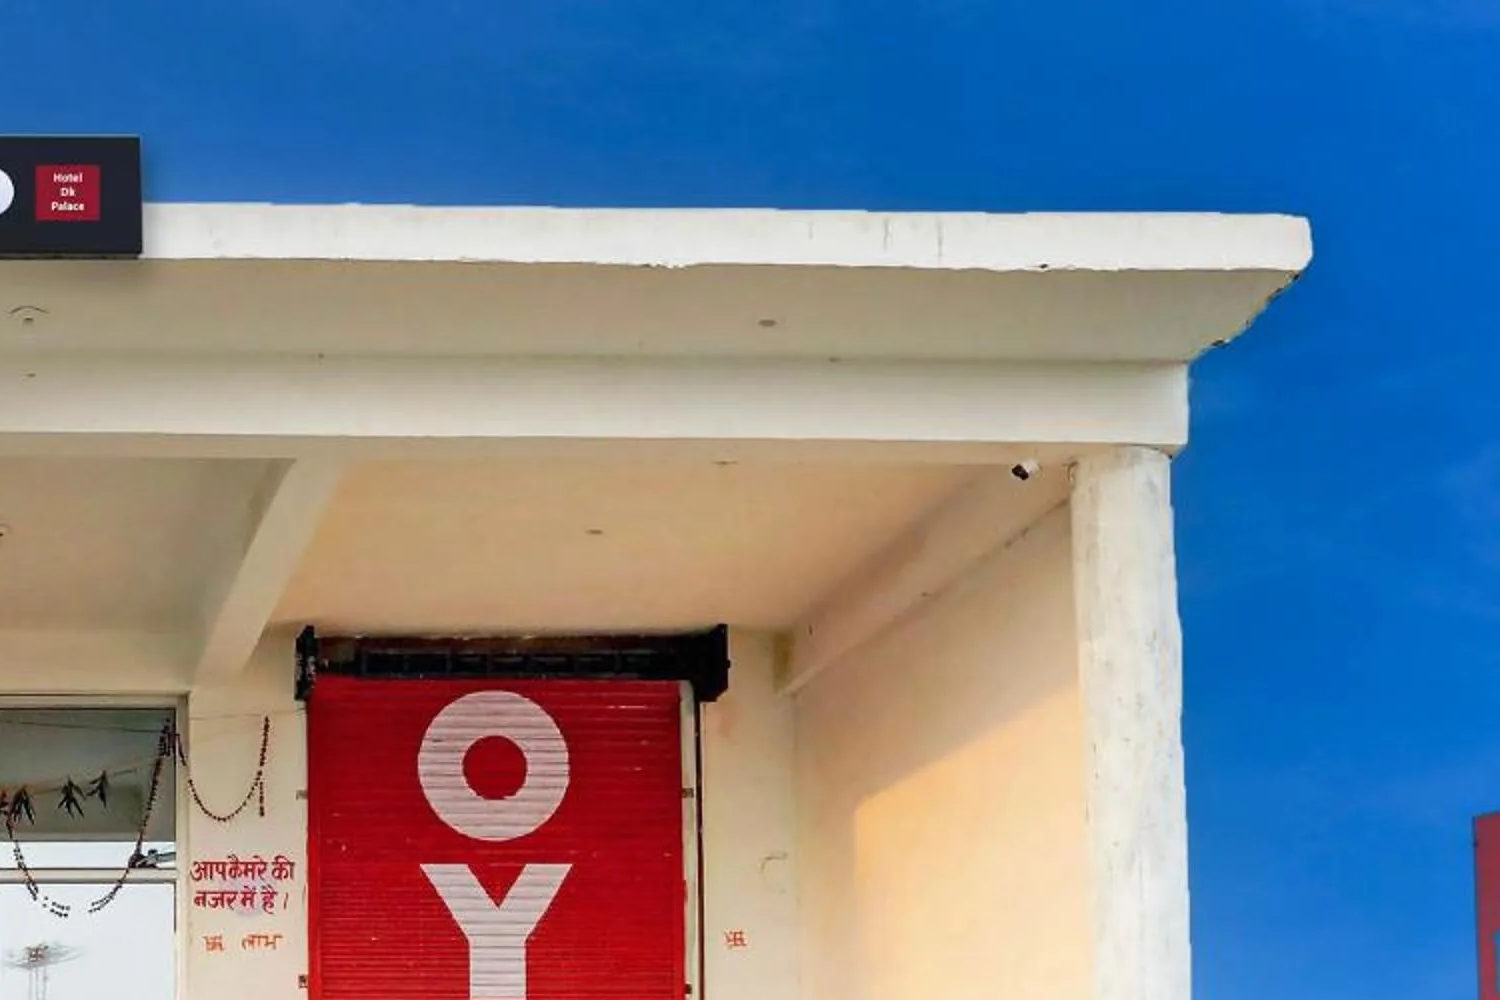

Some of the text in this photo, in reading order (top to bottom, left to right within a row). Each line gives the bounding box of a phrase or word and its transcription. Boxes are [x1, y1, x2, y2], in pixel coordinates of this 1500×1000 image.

[53, 171, 84, 183] Hotel
[60, 186, 77, 197] Dk
[51, 201, 85, 211] Palace
